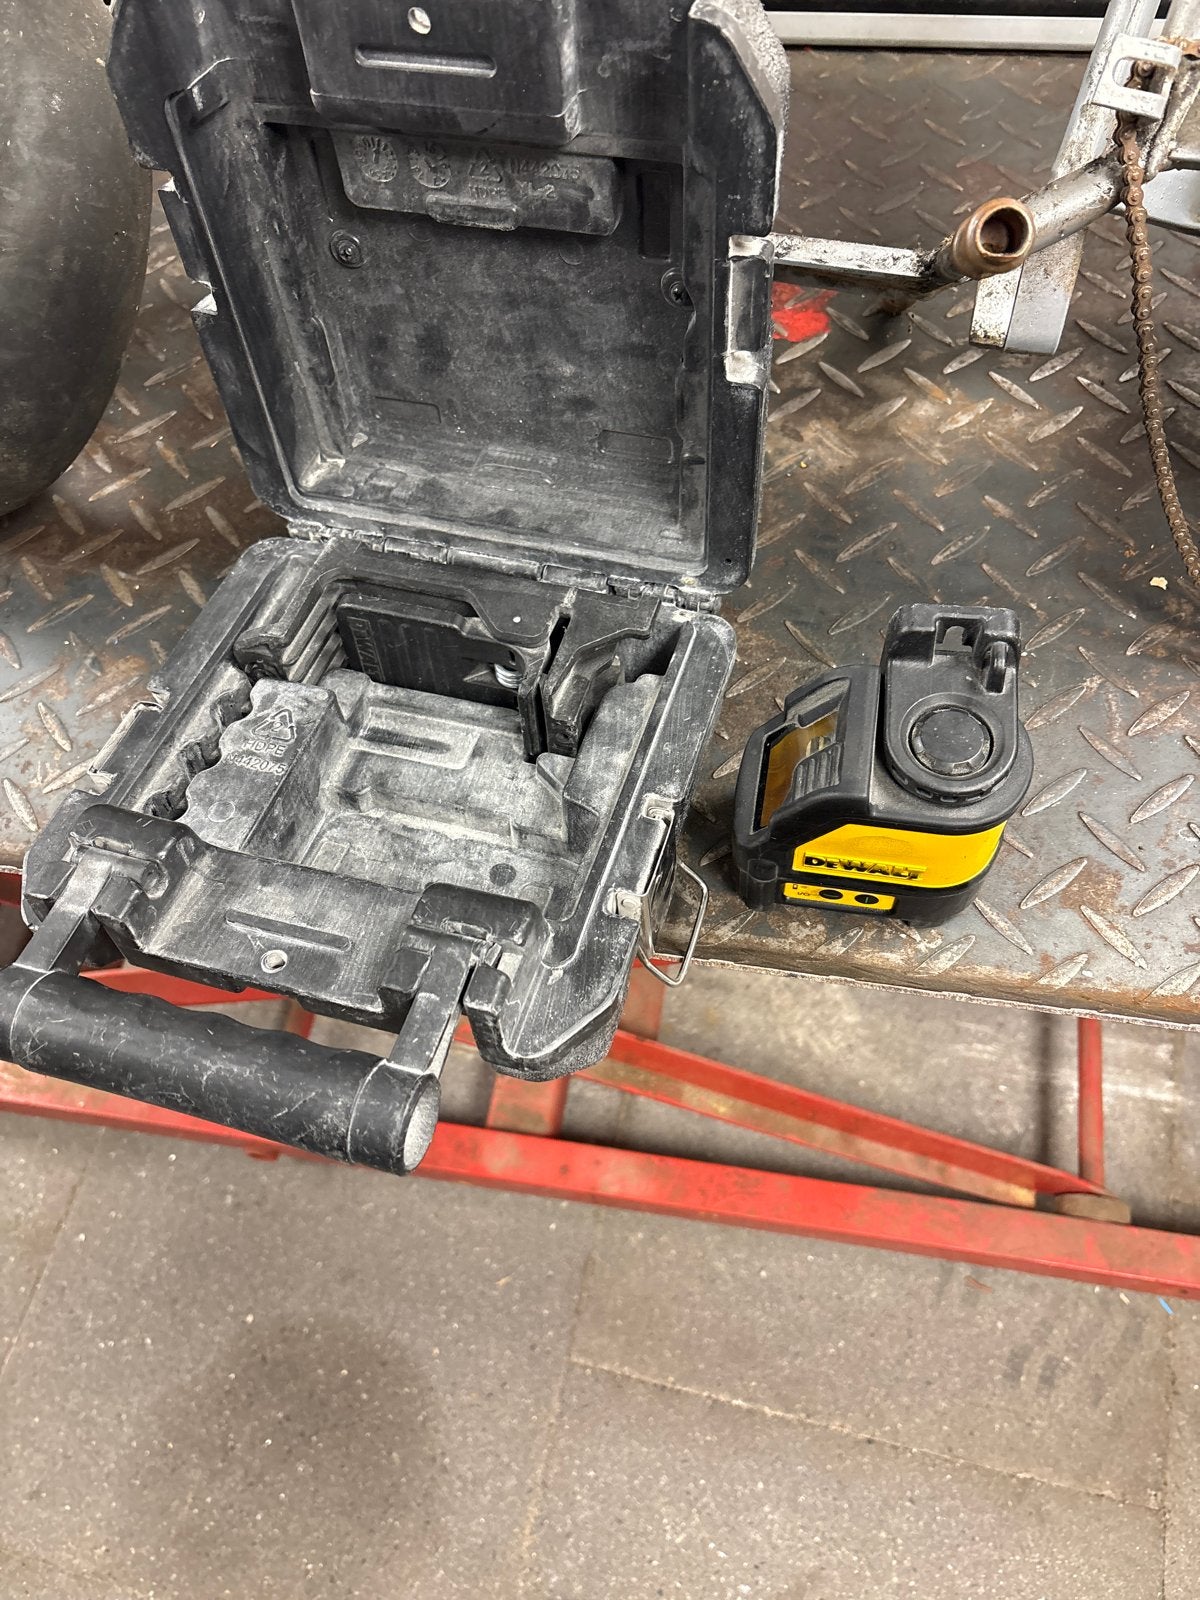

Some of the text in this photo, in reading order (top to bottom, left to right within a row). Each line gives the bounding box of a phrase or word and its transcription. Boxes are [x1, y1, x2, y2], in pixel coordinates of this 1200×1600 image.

[243, 740, 288, 757] HDPE
[226, 752, 288, 775] N442075
[803, 854, 924, 880] DEWALT
